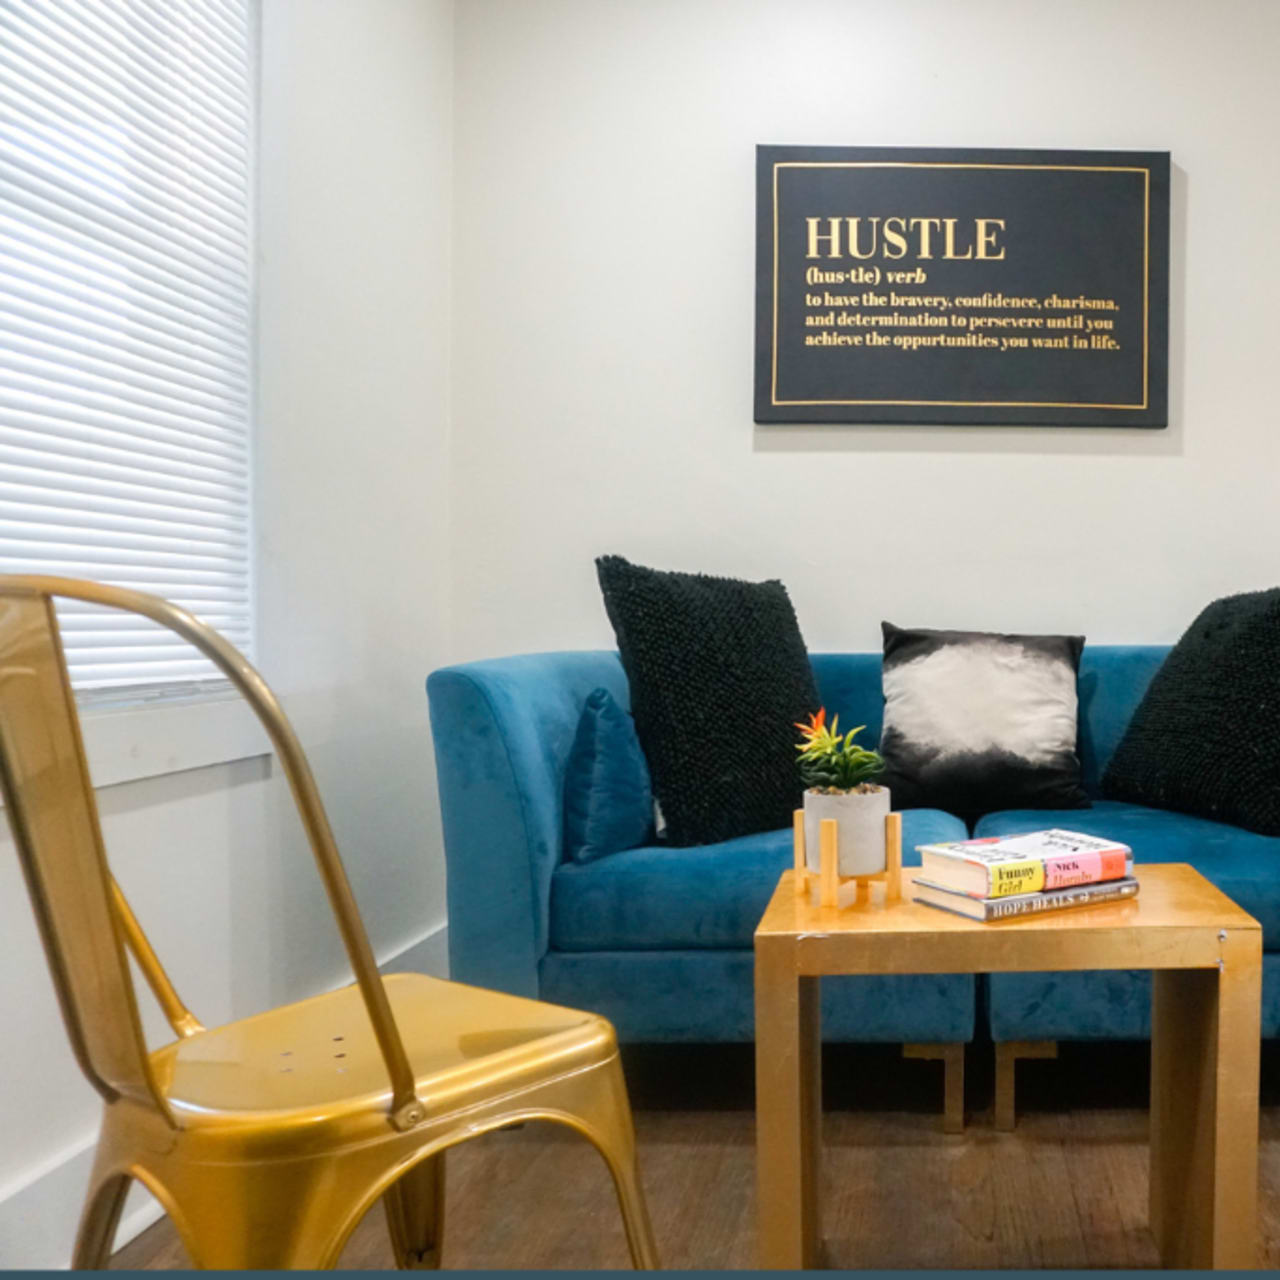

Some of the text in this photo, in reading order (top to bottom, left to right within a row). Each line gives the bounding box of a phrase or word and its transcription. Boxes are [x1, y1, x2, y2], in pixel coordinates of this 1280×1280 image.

[806, 217, 1006, 260] HUSTLE
[887, 267, 927, 284] verb
[806, 293, 822, 307] to
[824, 292, 860, 307] have
[862, 292, 888, 307] the
[890, 292, 953, 311] bravery,
[955, 293, 1042, 310] confidence,
[805, 311, 1114, 333] and determination to persevere until you
[805, 331, 1121, 351] achieve the oppurtunities you want in life.
[998, 865, 1036, 882] Funny
